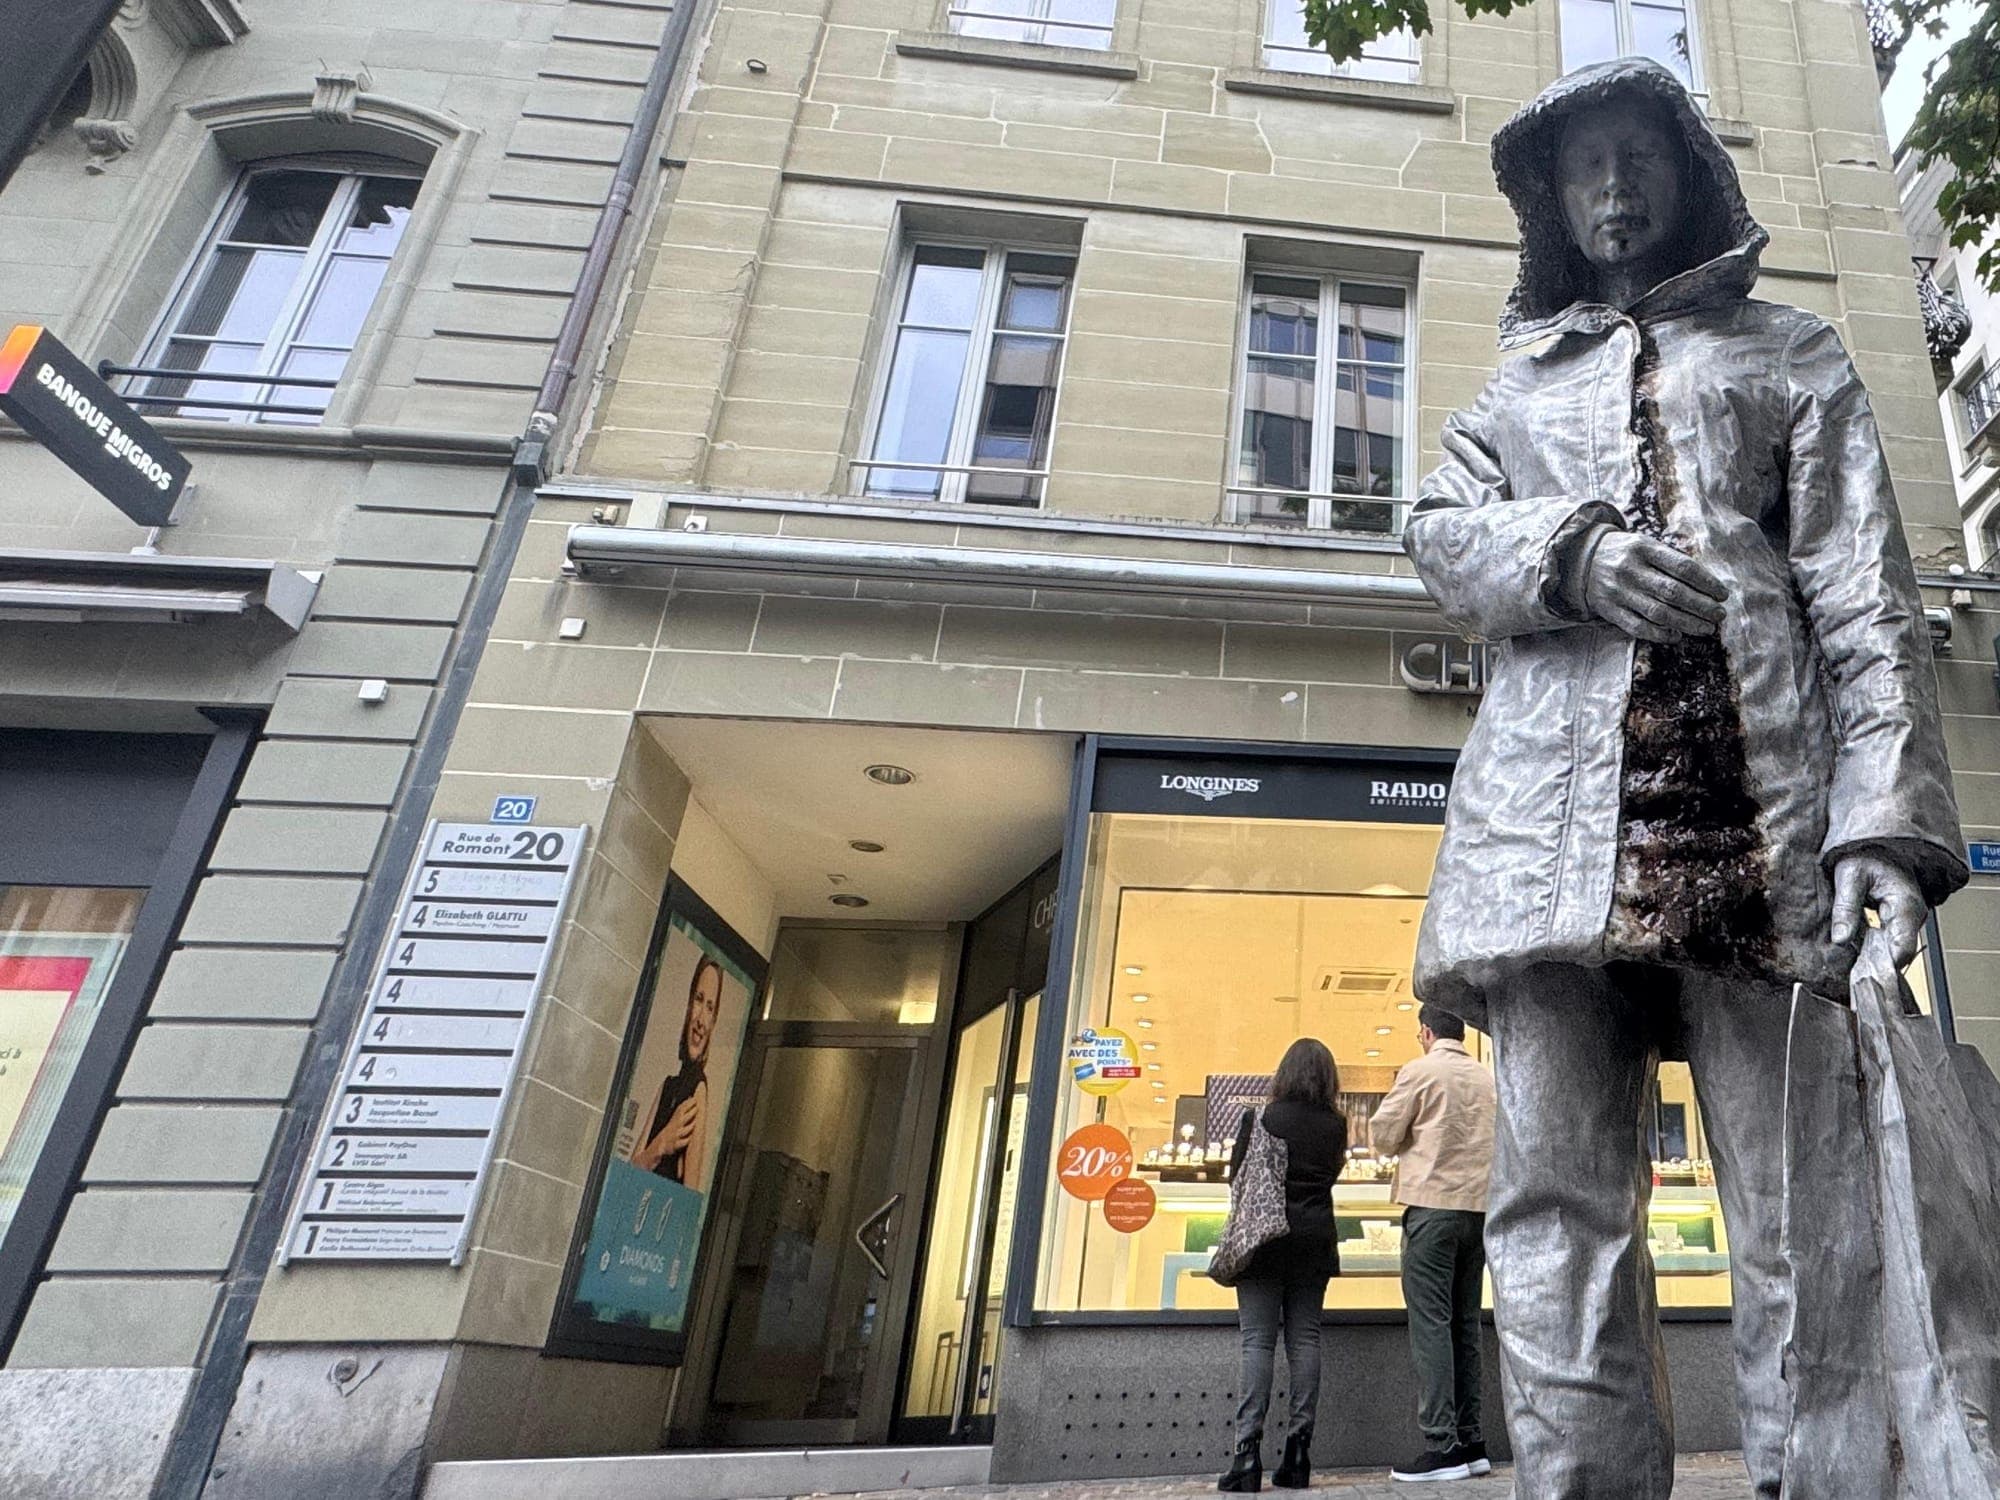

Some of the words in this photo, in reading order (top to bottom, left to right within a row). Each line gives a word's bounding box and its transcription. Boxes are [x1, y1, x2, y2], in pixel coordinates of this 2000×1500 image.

[36, 363, 112, 437] BANQUE
[104, 426, 173, 491] MIGROS
[1160, 775, 1261, 792] LONGINES
[1370, 781, 1446, 799] RADO
[499, 801, 527, 818] 20
[1369, 798, 1446, 807] SWITZERLAND
[442, 841, 511, 855] Romont
[458, 833, 482, 842] Rue
[485, 833, 501, 843] de
[508, 831, 564, 861] 20
[424, 870, 440, 893] 5
[412, 905, 429, 928] 4
[399, 942, 416, 965] 4
[386, 979, 404, 1003] 4
[373, 1017, 391, 1041] 4
[1068, 1049, 1095, 1057] AVEC
[1098, 1049, 1118, 1057] DES
[358, 1056, 377, 1081] 4
[346, 1096, 363, 1123] 3
[330, 1139, 349, 1167] 2
[319, 1182, 335, 1210] 1
[304, 1225, 320, 1254] 1
